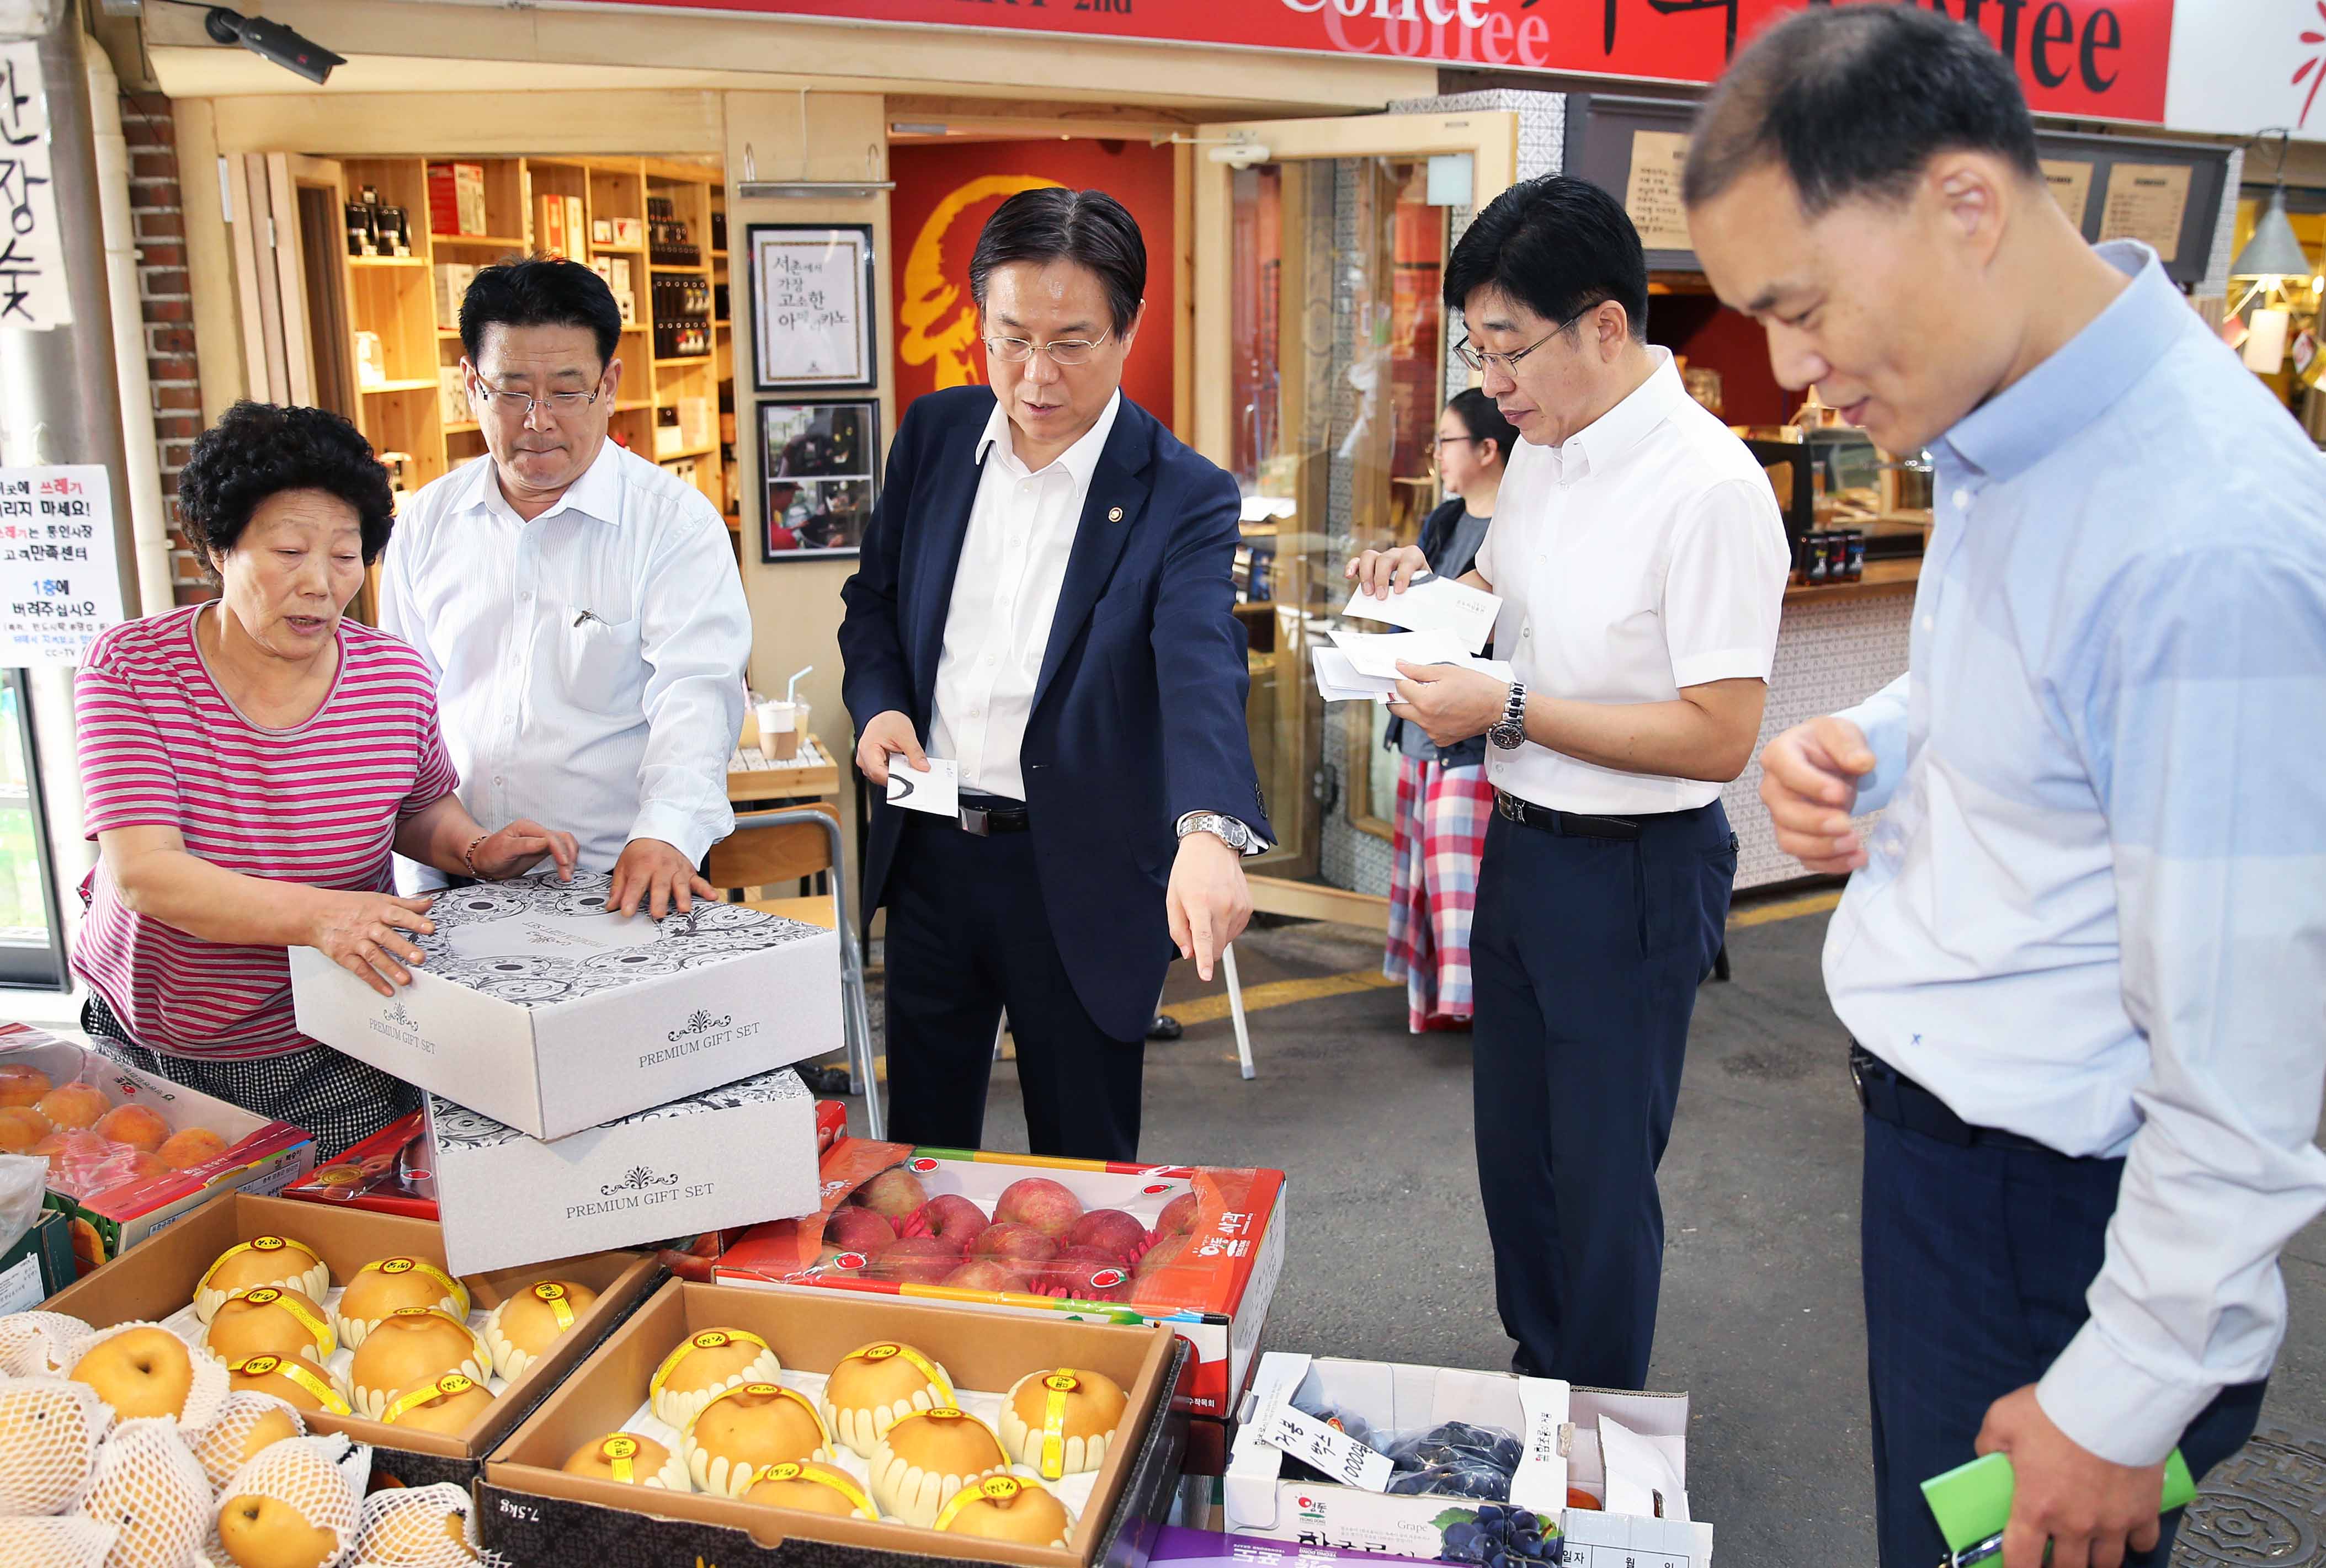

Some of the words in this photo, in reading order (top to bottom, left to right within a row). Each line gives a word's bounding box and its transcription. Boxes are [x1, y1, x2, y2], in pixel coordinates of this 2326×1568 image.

[779, 278, 803, 293] 가장
[778, 291, 824, 310] 고소한
[40, 477, 83, 494] 쓰레기
[0, 501, 32, 516] 리지
[40, 500, 91, 516] 마세요!
[12, 601, 97, 617] 버려주십시오
[369, 1018, 401, 1041] PREMIUM
[402, 1031, 419, 1048] GIFT
[421, 1039, 436, 1054] SET
[638, 1039, 700, 1069] PREMIUM
[703, 1030, 733, 1048] GIFT
[737, 1022, 760, 1039] SET
[566, 1196, 640, 1219] PREMIUM
[644, 1188, 680, 1206] GIFT
[685, 1182, 715, 1198] SET
[1217, 1211, 1245, 1234] 사과
[1275, 1418, 1304, 1446] 거봉
[1341, 1442, 1373, 1486] 10000원
[499, 1498, 539, 1522] 7.5kg
[1298, 1496, 1327, 1513] 영동
[1397, 1520, 1428, 1533] Grape
[1562, 1550, 1584, 1564] 일자
